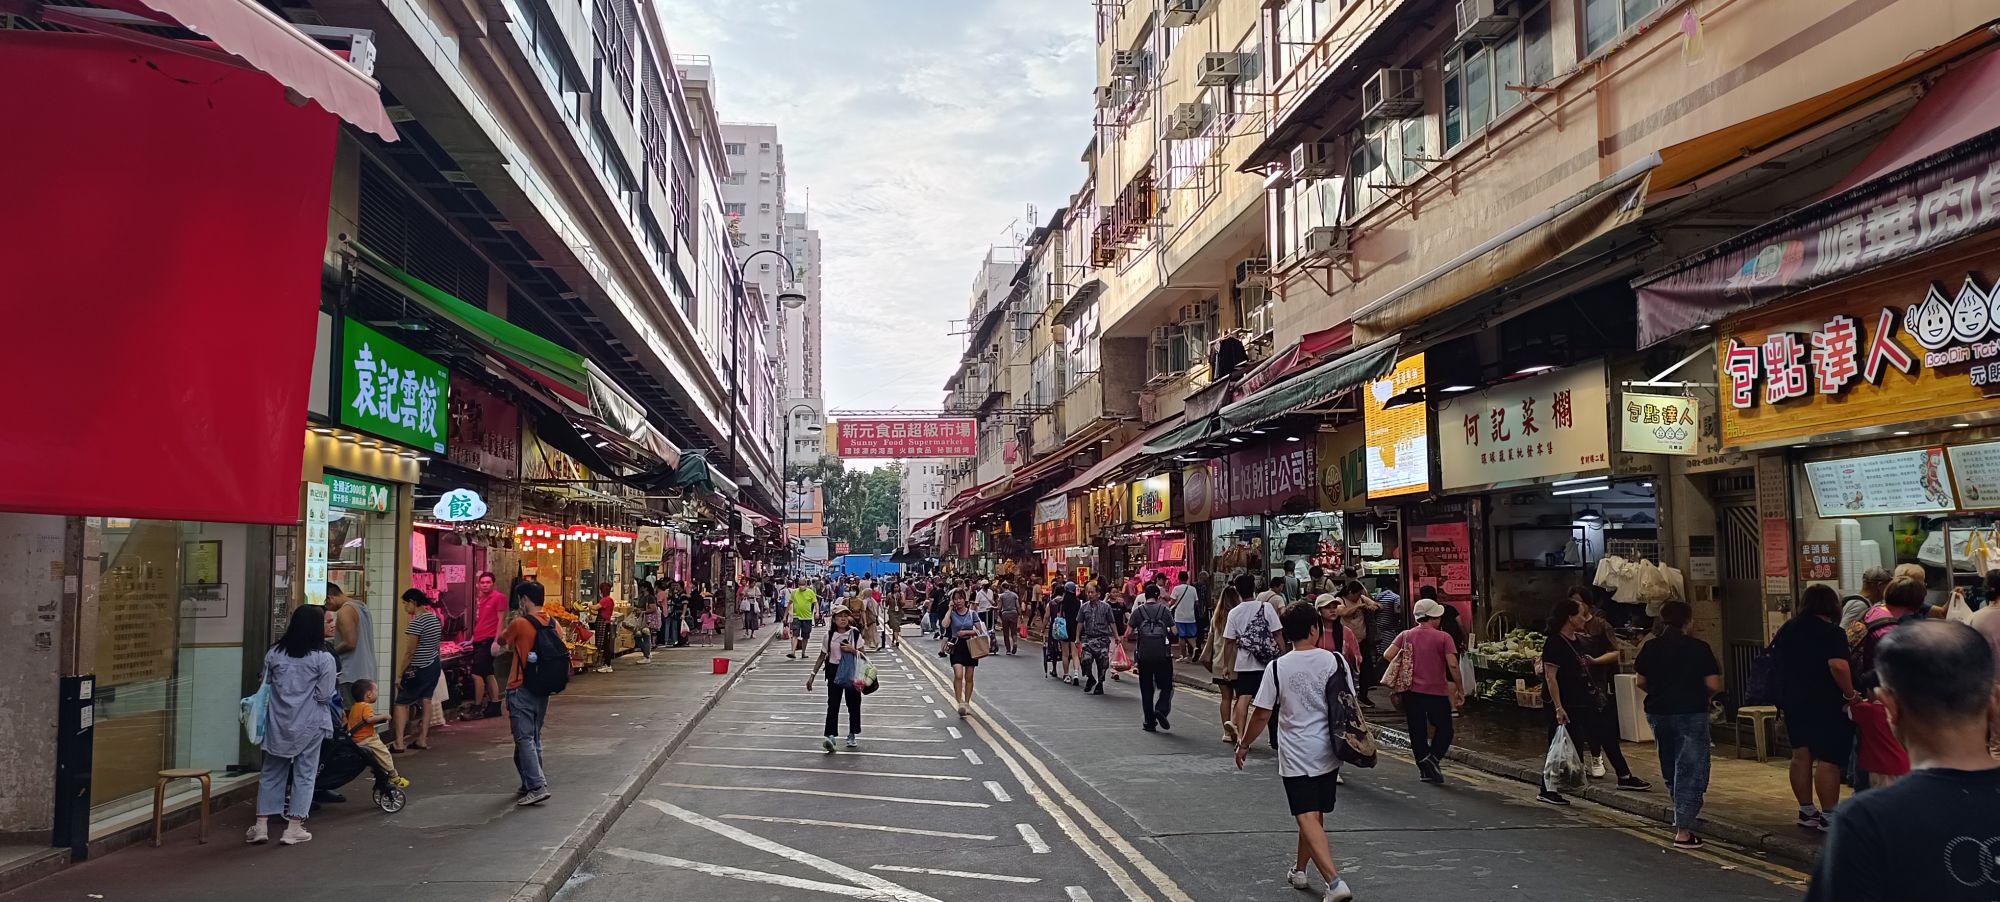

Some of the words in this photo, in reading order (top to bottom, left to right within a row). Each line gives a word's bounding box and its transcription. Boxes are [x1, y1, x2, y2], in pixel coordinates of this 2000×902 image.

[1724, 308, 1912, 408] 包點達人
[1972, 341, 1997, 359] Tat
[352, 342, 438, 437] 袁記雲餃
[1463, 388, 1573, 447] 何記菜欄
[1627, 401, 1694, 425] 包點達人
[843, 423, 971, 438] 新元食品超級市場
[909, 438, 963, 446] Supermarket
[448, 494, 472, 518] 餃
